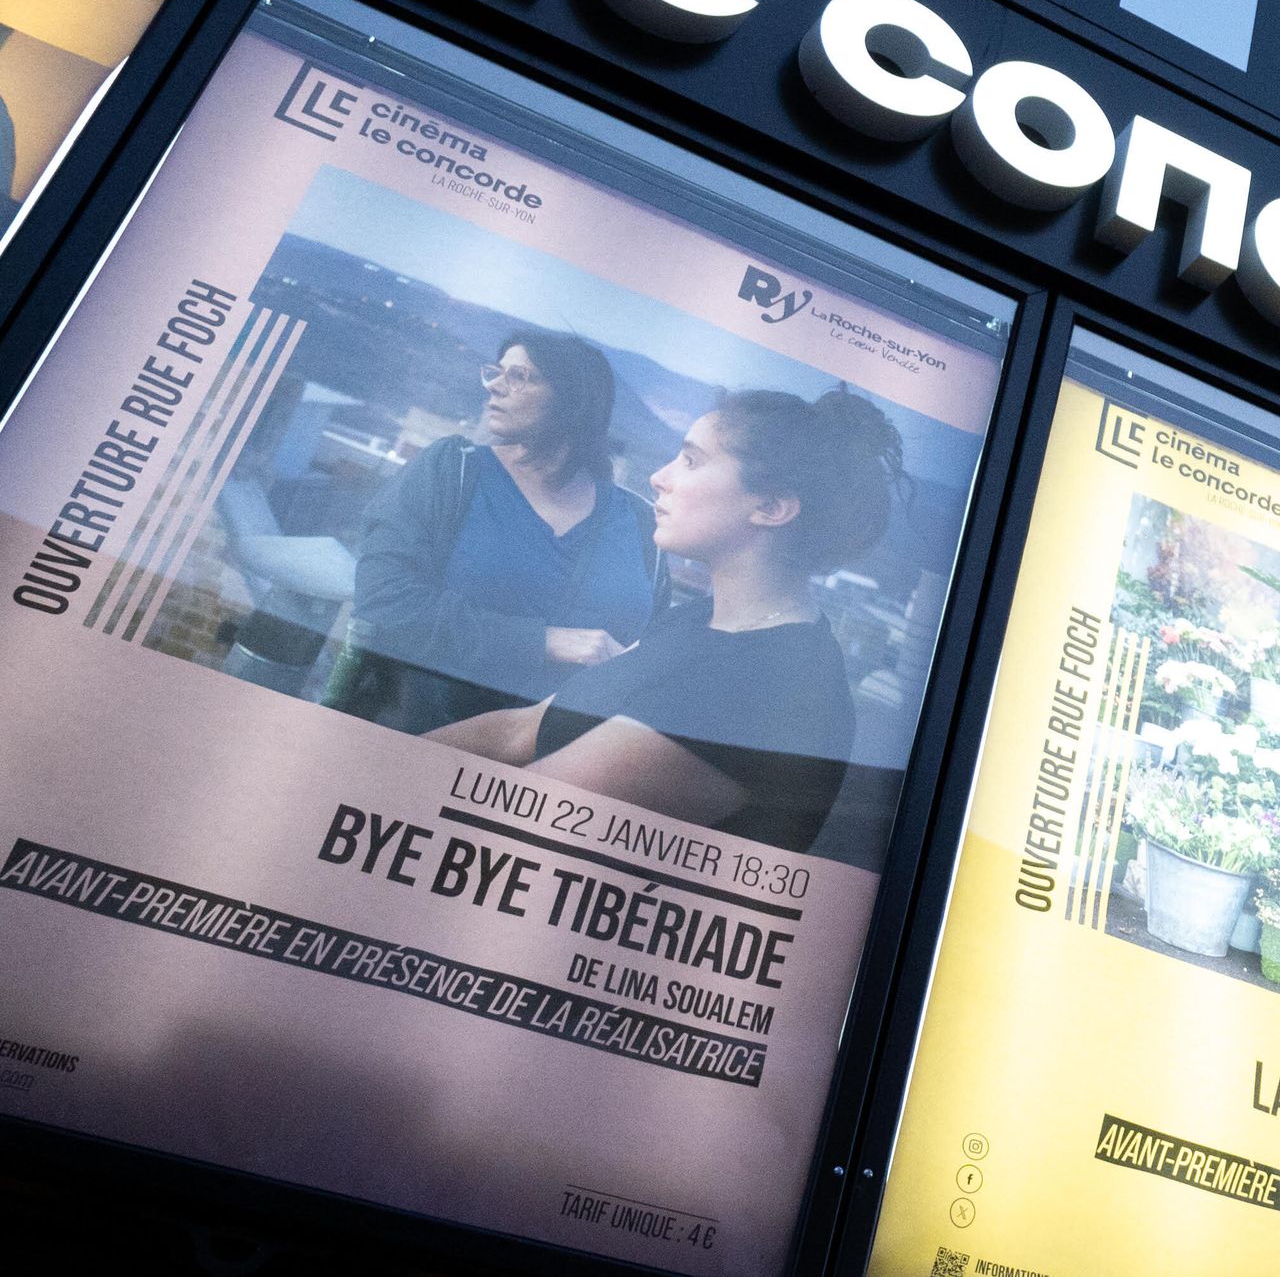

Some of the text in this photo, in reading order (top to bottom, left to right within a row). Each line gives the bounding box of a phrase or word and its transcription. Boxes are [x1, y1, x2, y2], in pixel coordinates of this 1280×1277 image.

[370, 102, 488, 162] cinéma
[396, 139, 543, 210] concorde
[447, 178, 537, 225] ROCHE-SUR-YON
[12, 278, 238, 615] OUVERTURE RUE FOCH
[1155, 430, 1240, 477] cinéma
[1015, 606, 1101, 913] OUVERTURE RUE FOCH
[450, 766, 811, 899] LUNDI 22 JANVIER 18:30
[317, 804, 795, 989] BYE BYE TIBÉRIADE
[2, 851, 767, 1082] AVANT-PREMIÈRE EN PRÉSENCE DE LA RÉALISATRICE
[567, 953, 775, 1035] DE LINA SOUALEM
[1097, 1122, 1280, 1201] AVANT-PREMIÈRE
[560, 1191, 611, 1223] TARIF
[611, 1204, 677, 1242] UNIQUE
